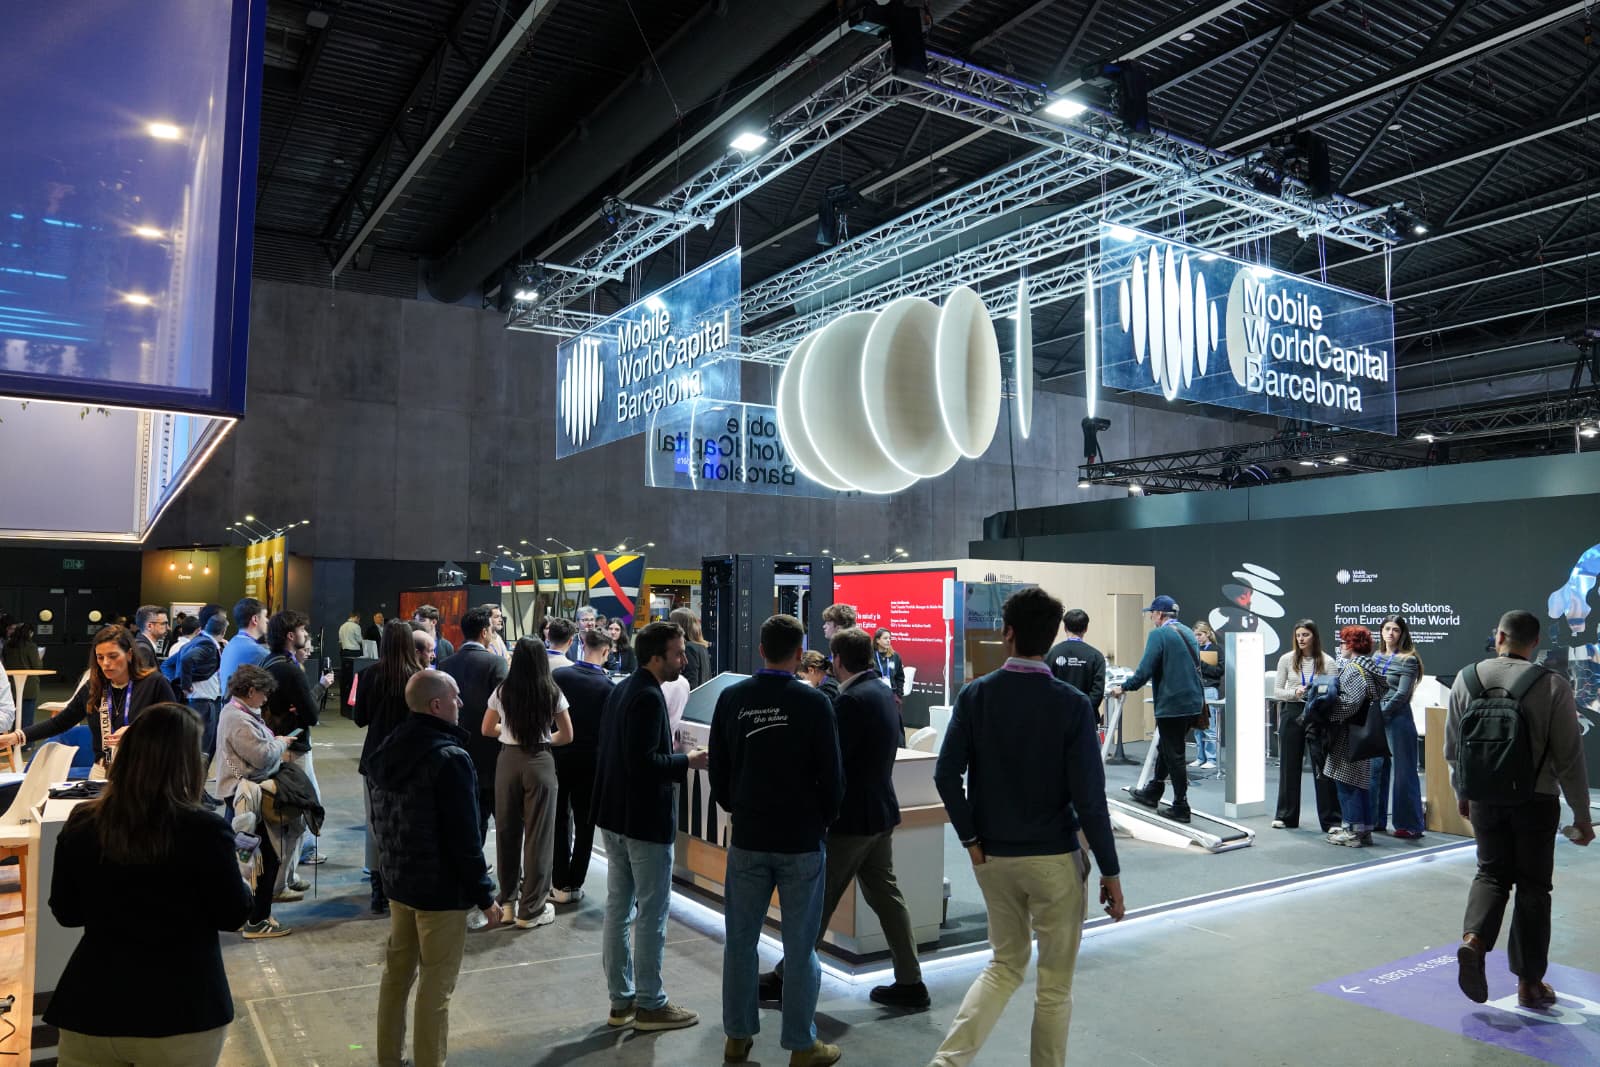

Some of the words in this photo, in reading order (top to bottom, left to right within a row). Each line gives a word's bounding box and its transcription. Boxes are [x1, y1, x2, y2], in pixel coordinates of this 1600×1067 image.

[1242, 278, 1322, 330] Mobile
[617, 309, 669, 355] Mobile
[617, 310, 730, 387] WorldCapital
[1242, 317, 1388, 383] WorldCapital
[617, 370, 703, 422] Barcelona
[1244, 356, 1362, 412] Barcelona
[1334, 603, 1359, 613] From
[1362, 603, 1387, 613] Ideas
[1389, 604, 1400, 613] to
[1401, 603, 1453, 614] Solutions,
[1334, 615, 1358, 625] from
[1360, 615, 1385, 625] Euro
[1410, 616, 1426, 625] the
[1428, 615, 1460, 626] World
[737, 706, 780, 720] Empowering
